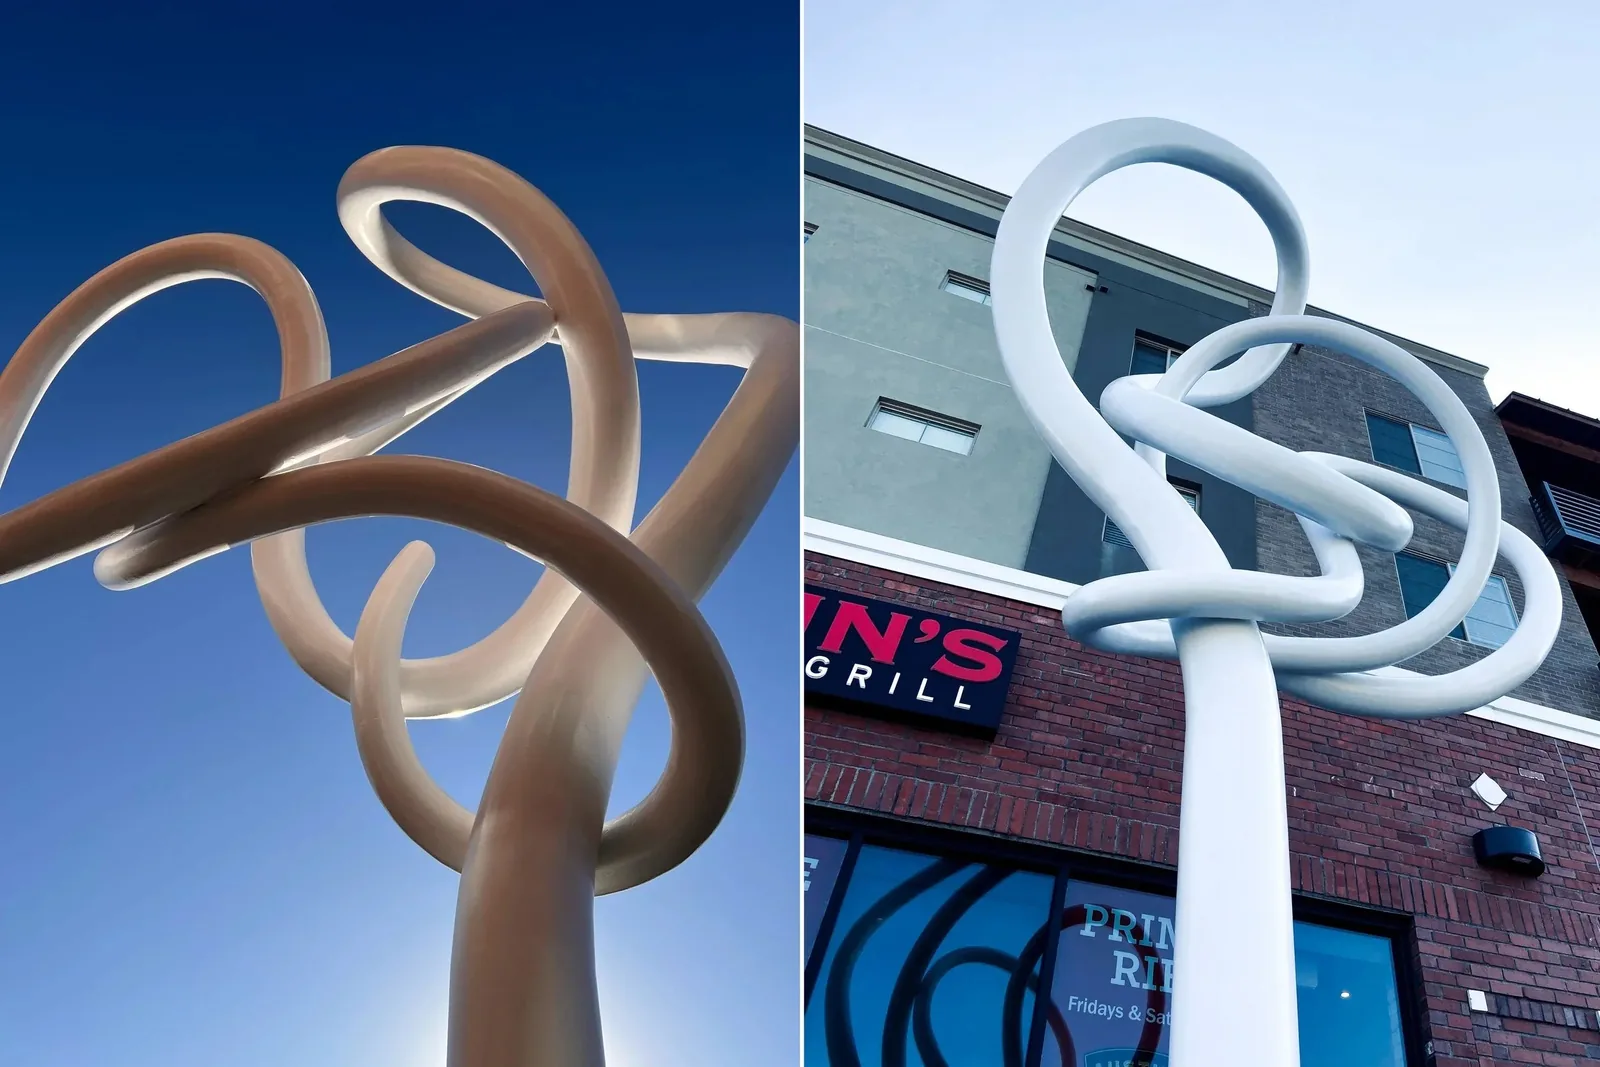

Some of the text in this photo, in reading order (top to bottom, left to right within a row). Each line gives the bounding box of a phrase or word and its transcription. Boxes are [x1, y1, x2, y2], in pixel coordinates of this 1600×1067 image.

[805, 655, 971, 710] GRILL
[1068, 996, 1123, 1020] Fridays
[1128, 1005, 1141, 1021] &
